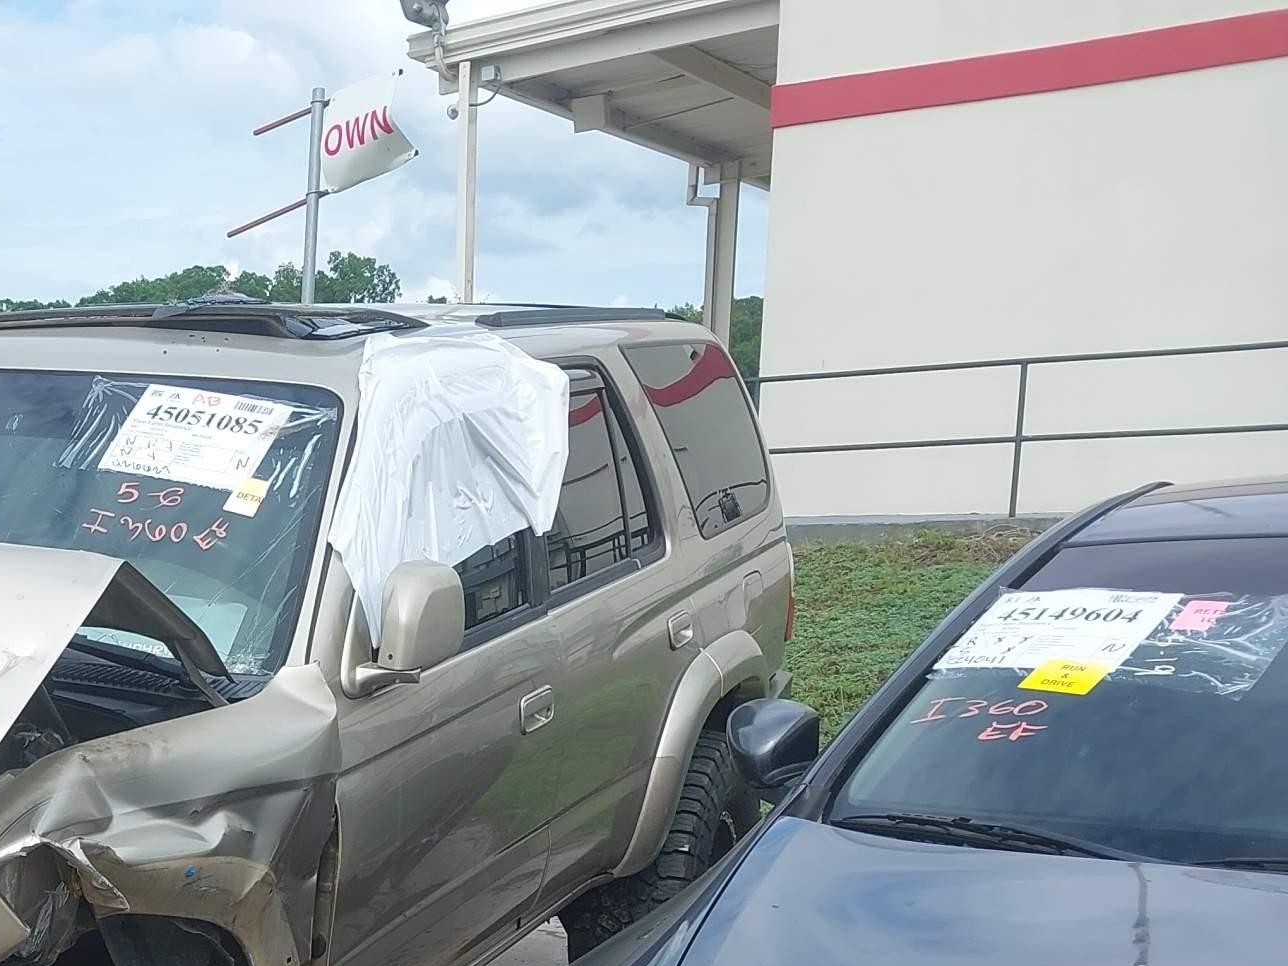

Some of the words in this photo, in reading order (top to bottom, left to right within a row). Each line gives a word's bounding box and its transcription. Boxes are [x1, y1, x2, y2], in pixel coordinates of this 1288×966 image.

[324, 105, 394, 156] OWN
[146, 404, 264, 435] 45051085
[997, 606, 1144, 623] 45149604
[1060, 664, 1088, 673] RUN
[1040, 678, 1077, 689] DRIVE
